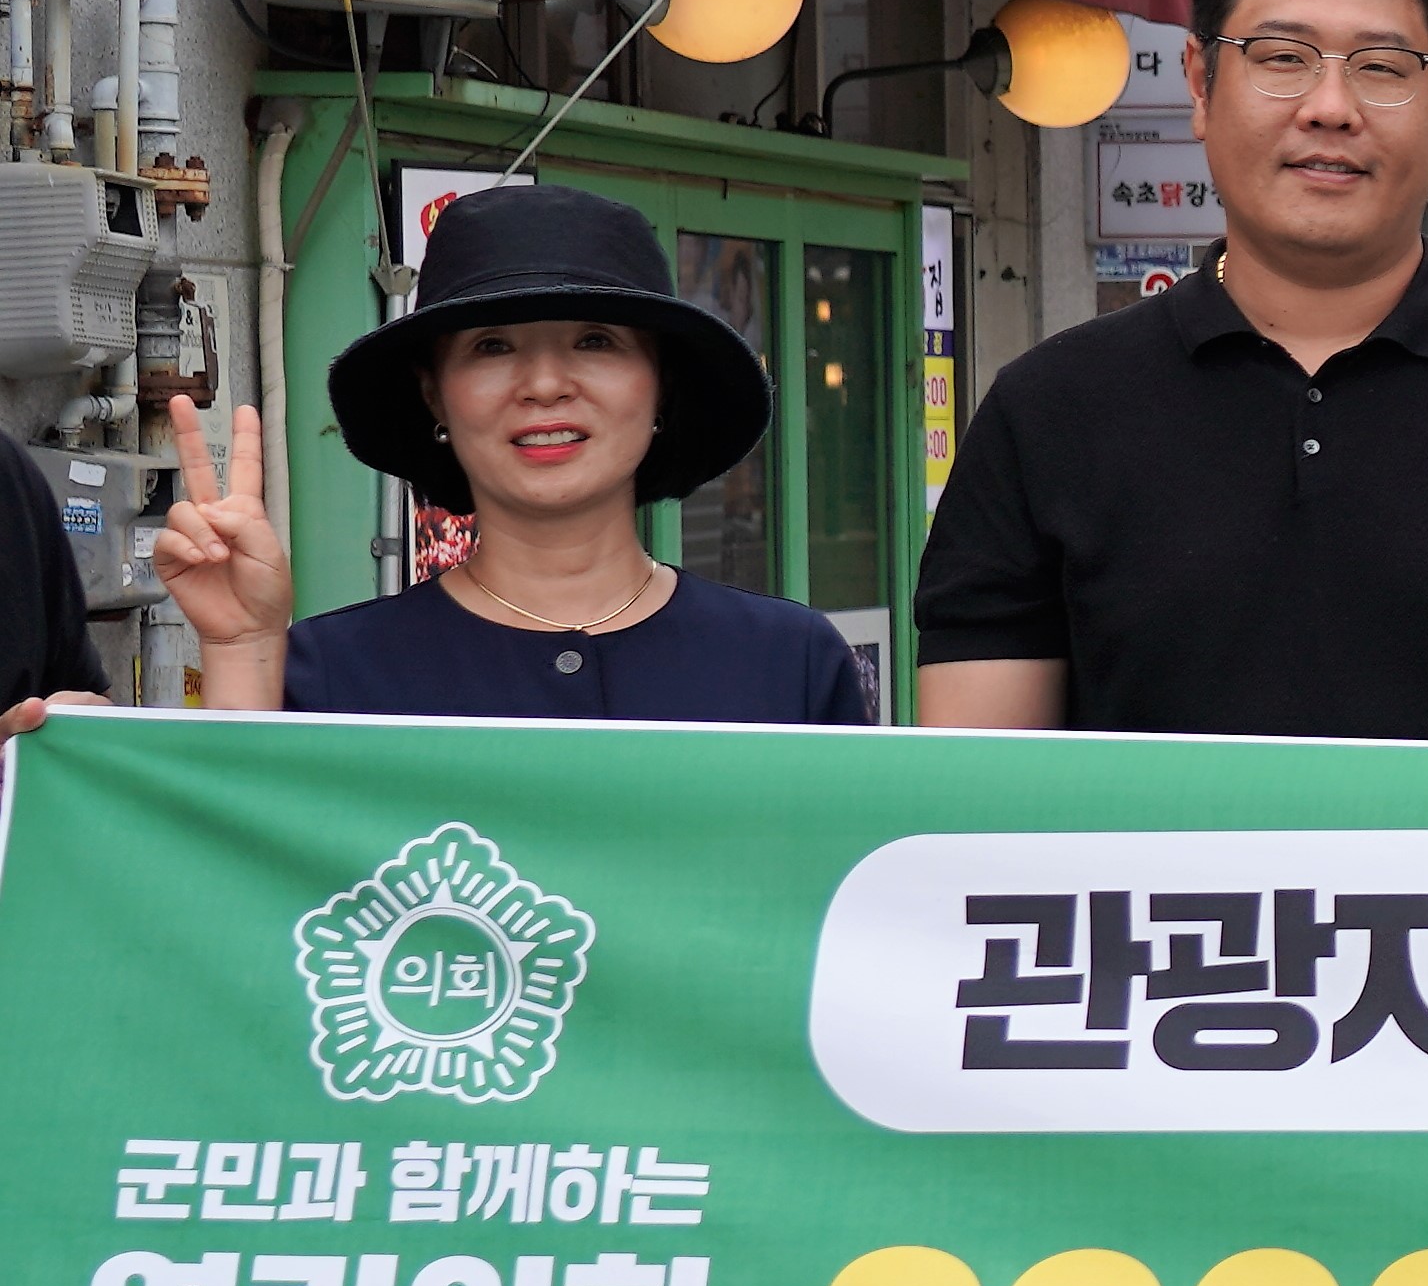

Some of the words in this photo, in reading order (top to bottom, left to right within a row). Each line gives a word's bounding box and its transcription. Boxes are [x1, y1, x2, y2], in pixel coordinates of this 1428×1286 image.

[388, 951, 499, 1011] 의회
[114, 1139, 368, 1225] 군민과
[389, 1140, 712, 1226] 함께하는
